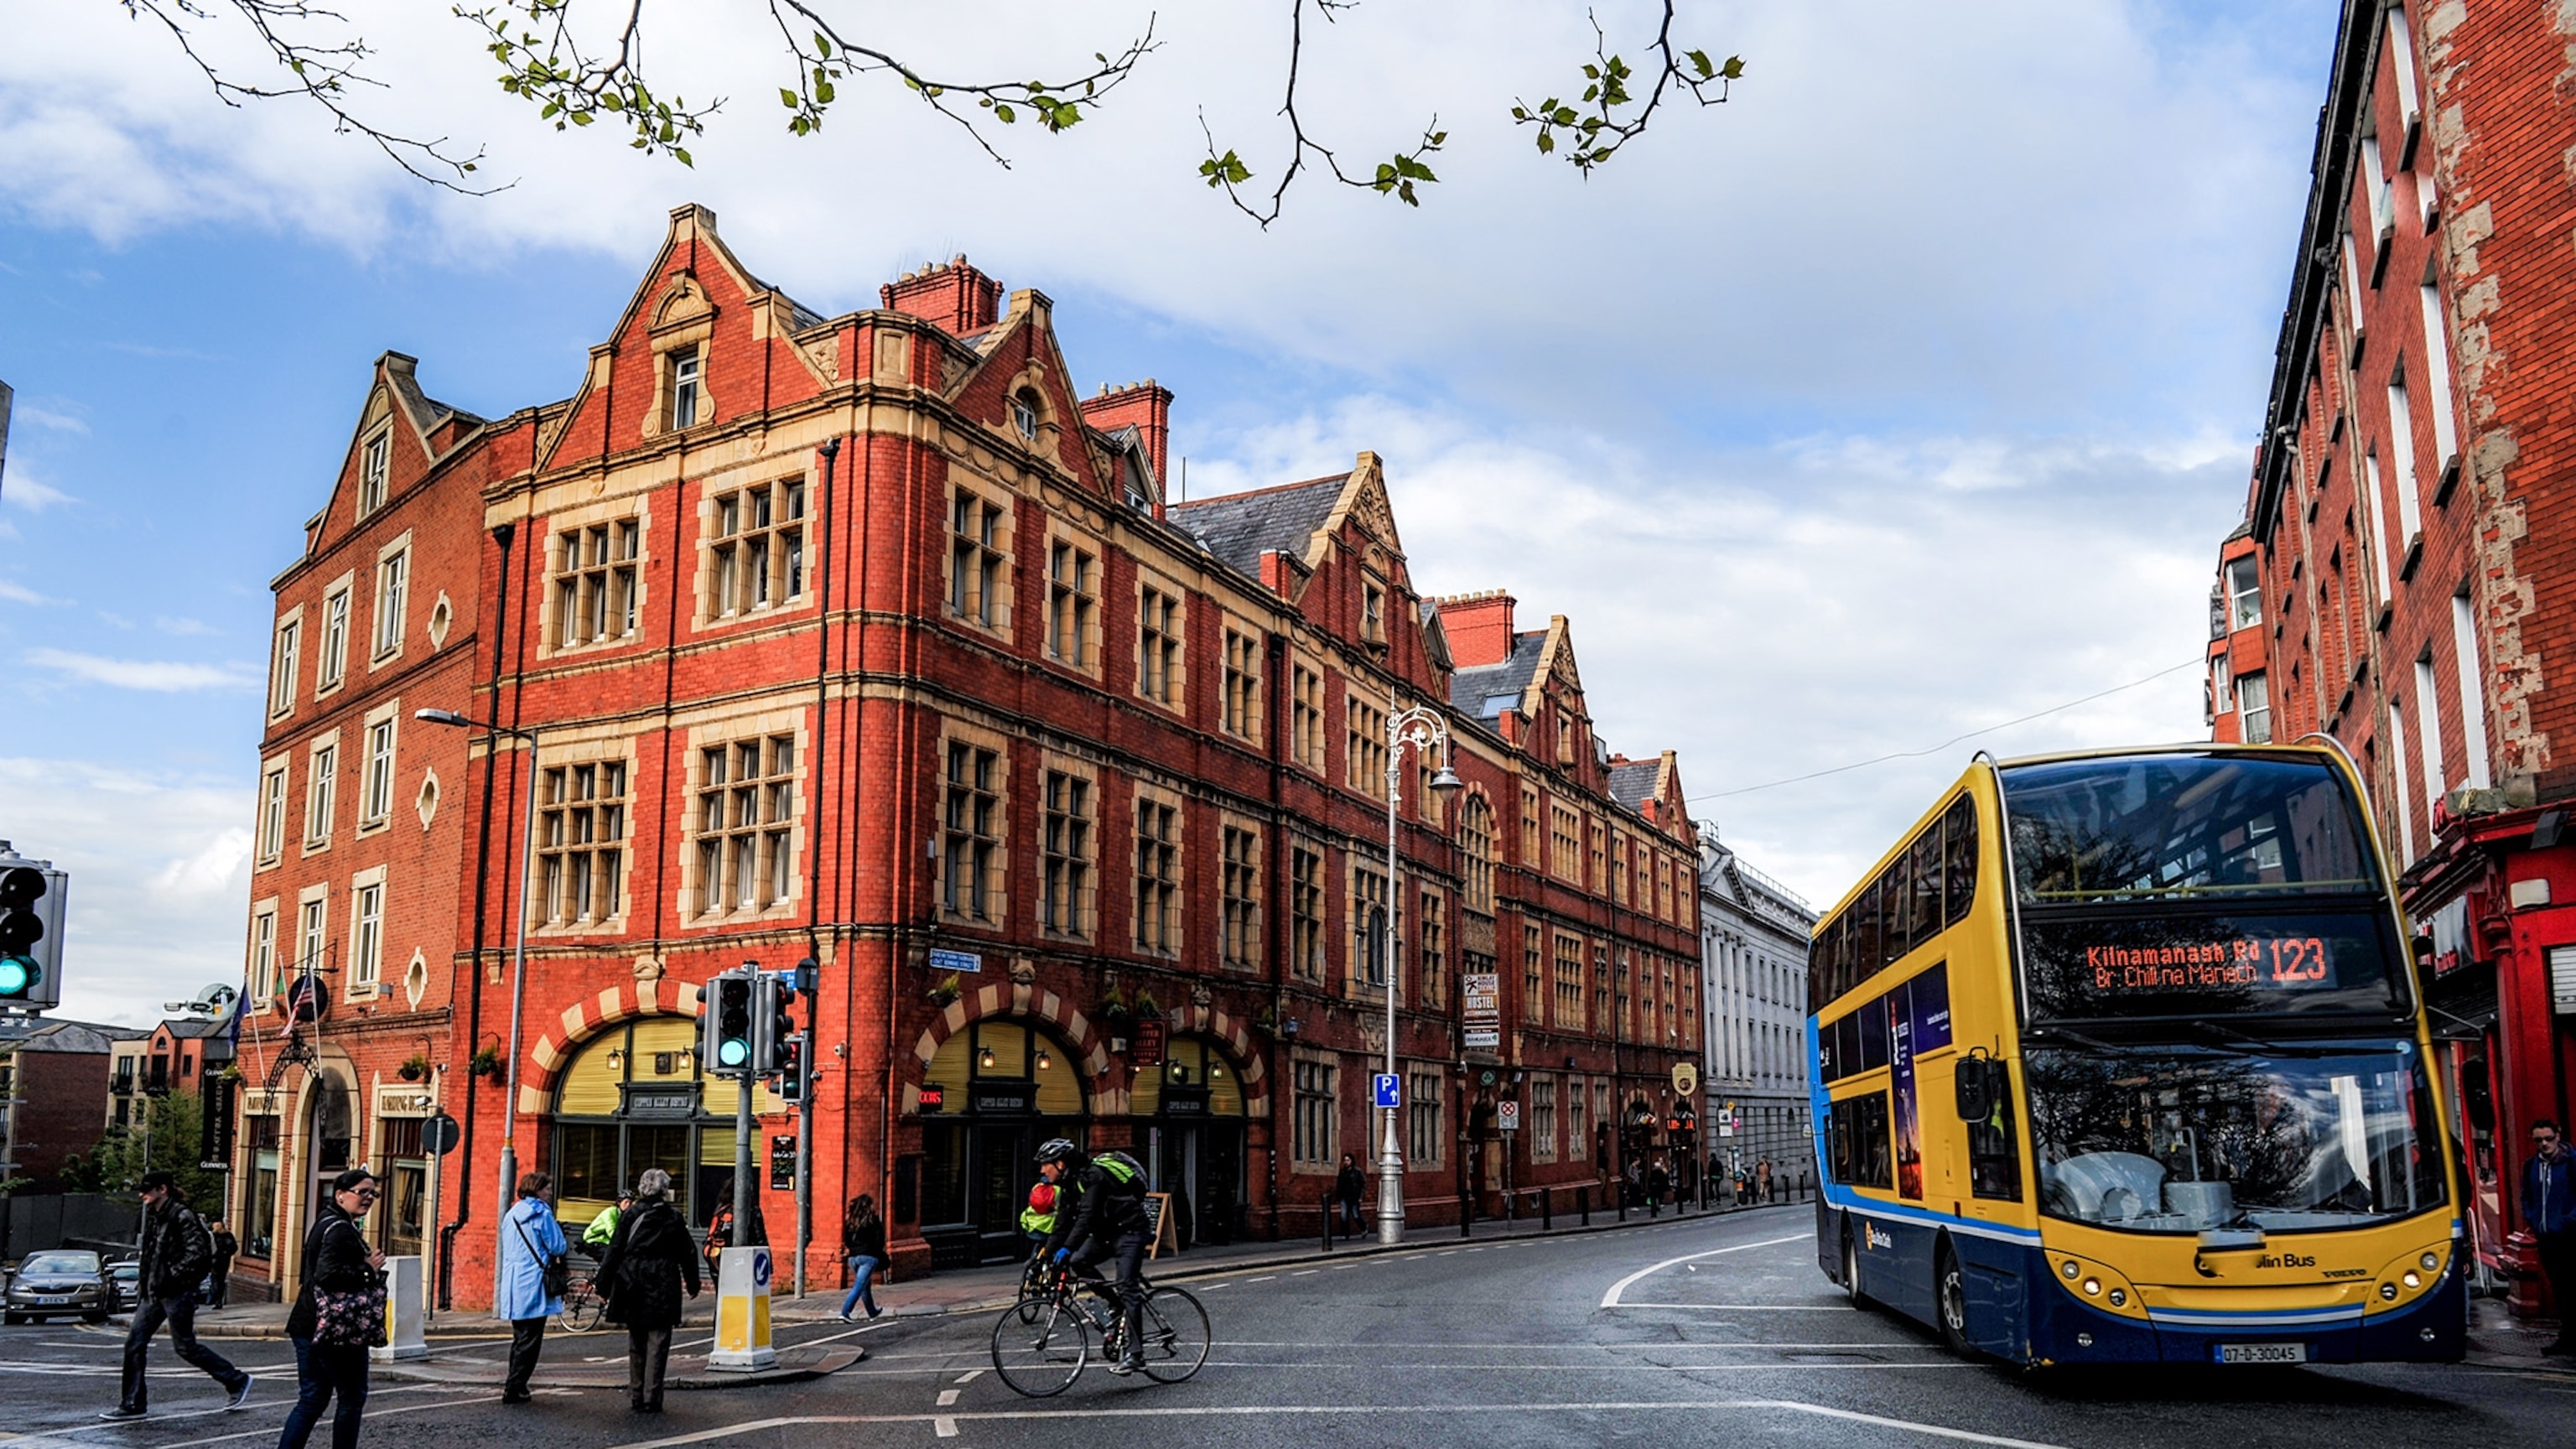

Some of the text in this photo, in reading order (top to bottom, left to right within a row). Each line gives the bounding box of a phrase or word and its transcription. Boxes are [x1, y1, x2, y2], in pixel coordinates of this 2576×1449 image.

[2232, 940, 2260, 962] Rd
[2269, 937, 2327, 981] 123
[2125, 965, 2158, 987] Chill
[2162, 968, 2184, 985] na
[2188, 962, 2258, 984] Manach
[1467, 996, 1494, 1010] HOSTEL
[205, 1068, 224, 1077] GUINN
[1382, 1077, 1393, 1092] P
[200, 1160, 228, 1169] GUINNESS
[2283, 1253, 2316, 1268] Bus
[2224, 1347, 2296, 1361] 07-D-30045
